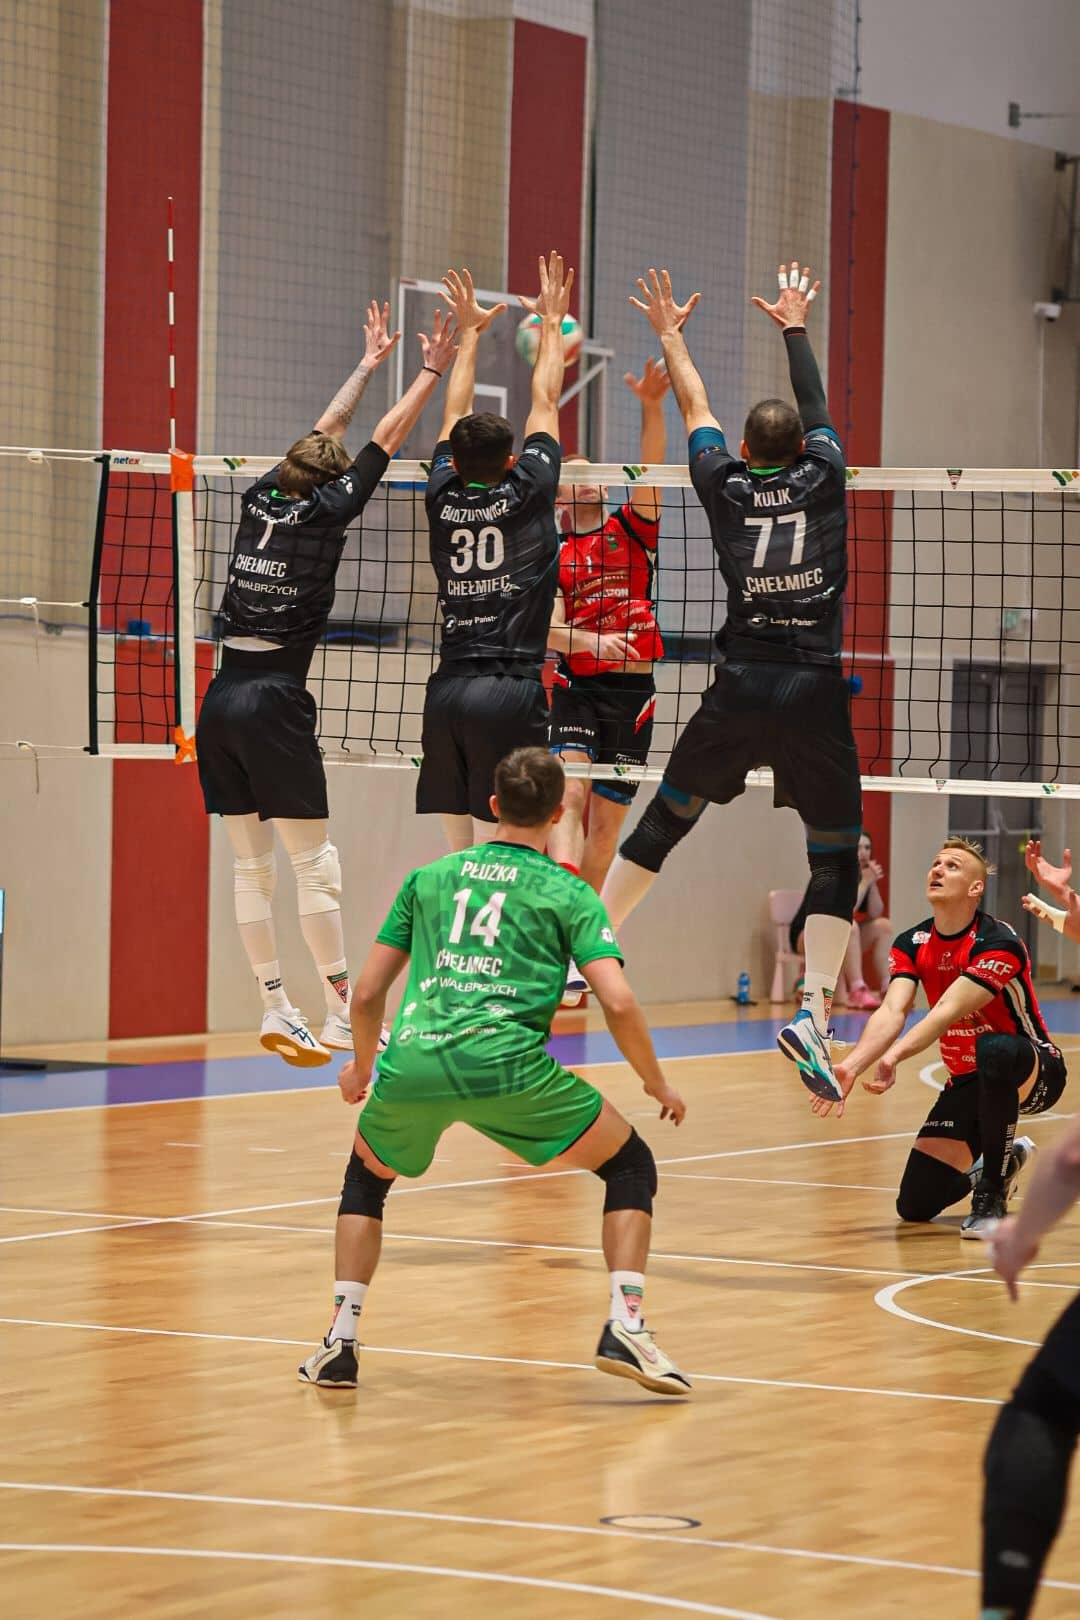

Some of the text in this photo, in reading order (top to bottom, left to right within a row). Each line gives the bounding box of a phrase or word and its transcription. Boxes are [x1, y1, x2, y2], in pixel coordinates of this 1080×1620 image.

[113, 456, 140, 465] netex
[754, 487, 792, 507] KULIK
[450, 525, 505, 574] 30
[744, 511, 807, 568] 77
[235, 554, 287, 578] CHEŁMIEC
[237, 579, 298, 596] WAŁBRZYCH
[447, 575, 512, 597] CHEŁMIEC
[746, 568, 823, 594] CHEŁMIEC
[461, 861, 518, 882] PŁUŻKA
[449, 888, 507, 947] 14
[436, 948, 502, 977] CHEŁMIEC
[976, 958, 1013, 976] MCF
[440, 977, 517, 997] WAŁBRZYCH
